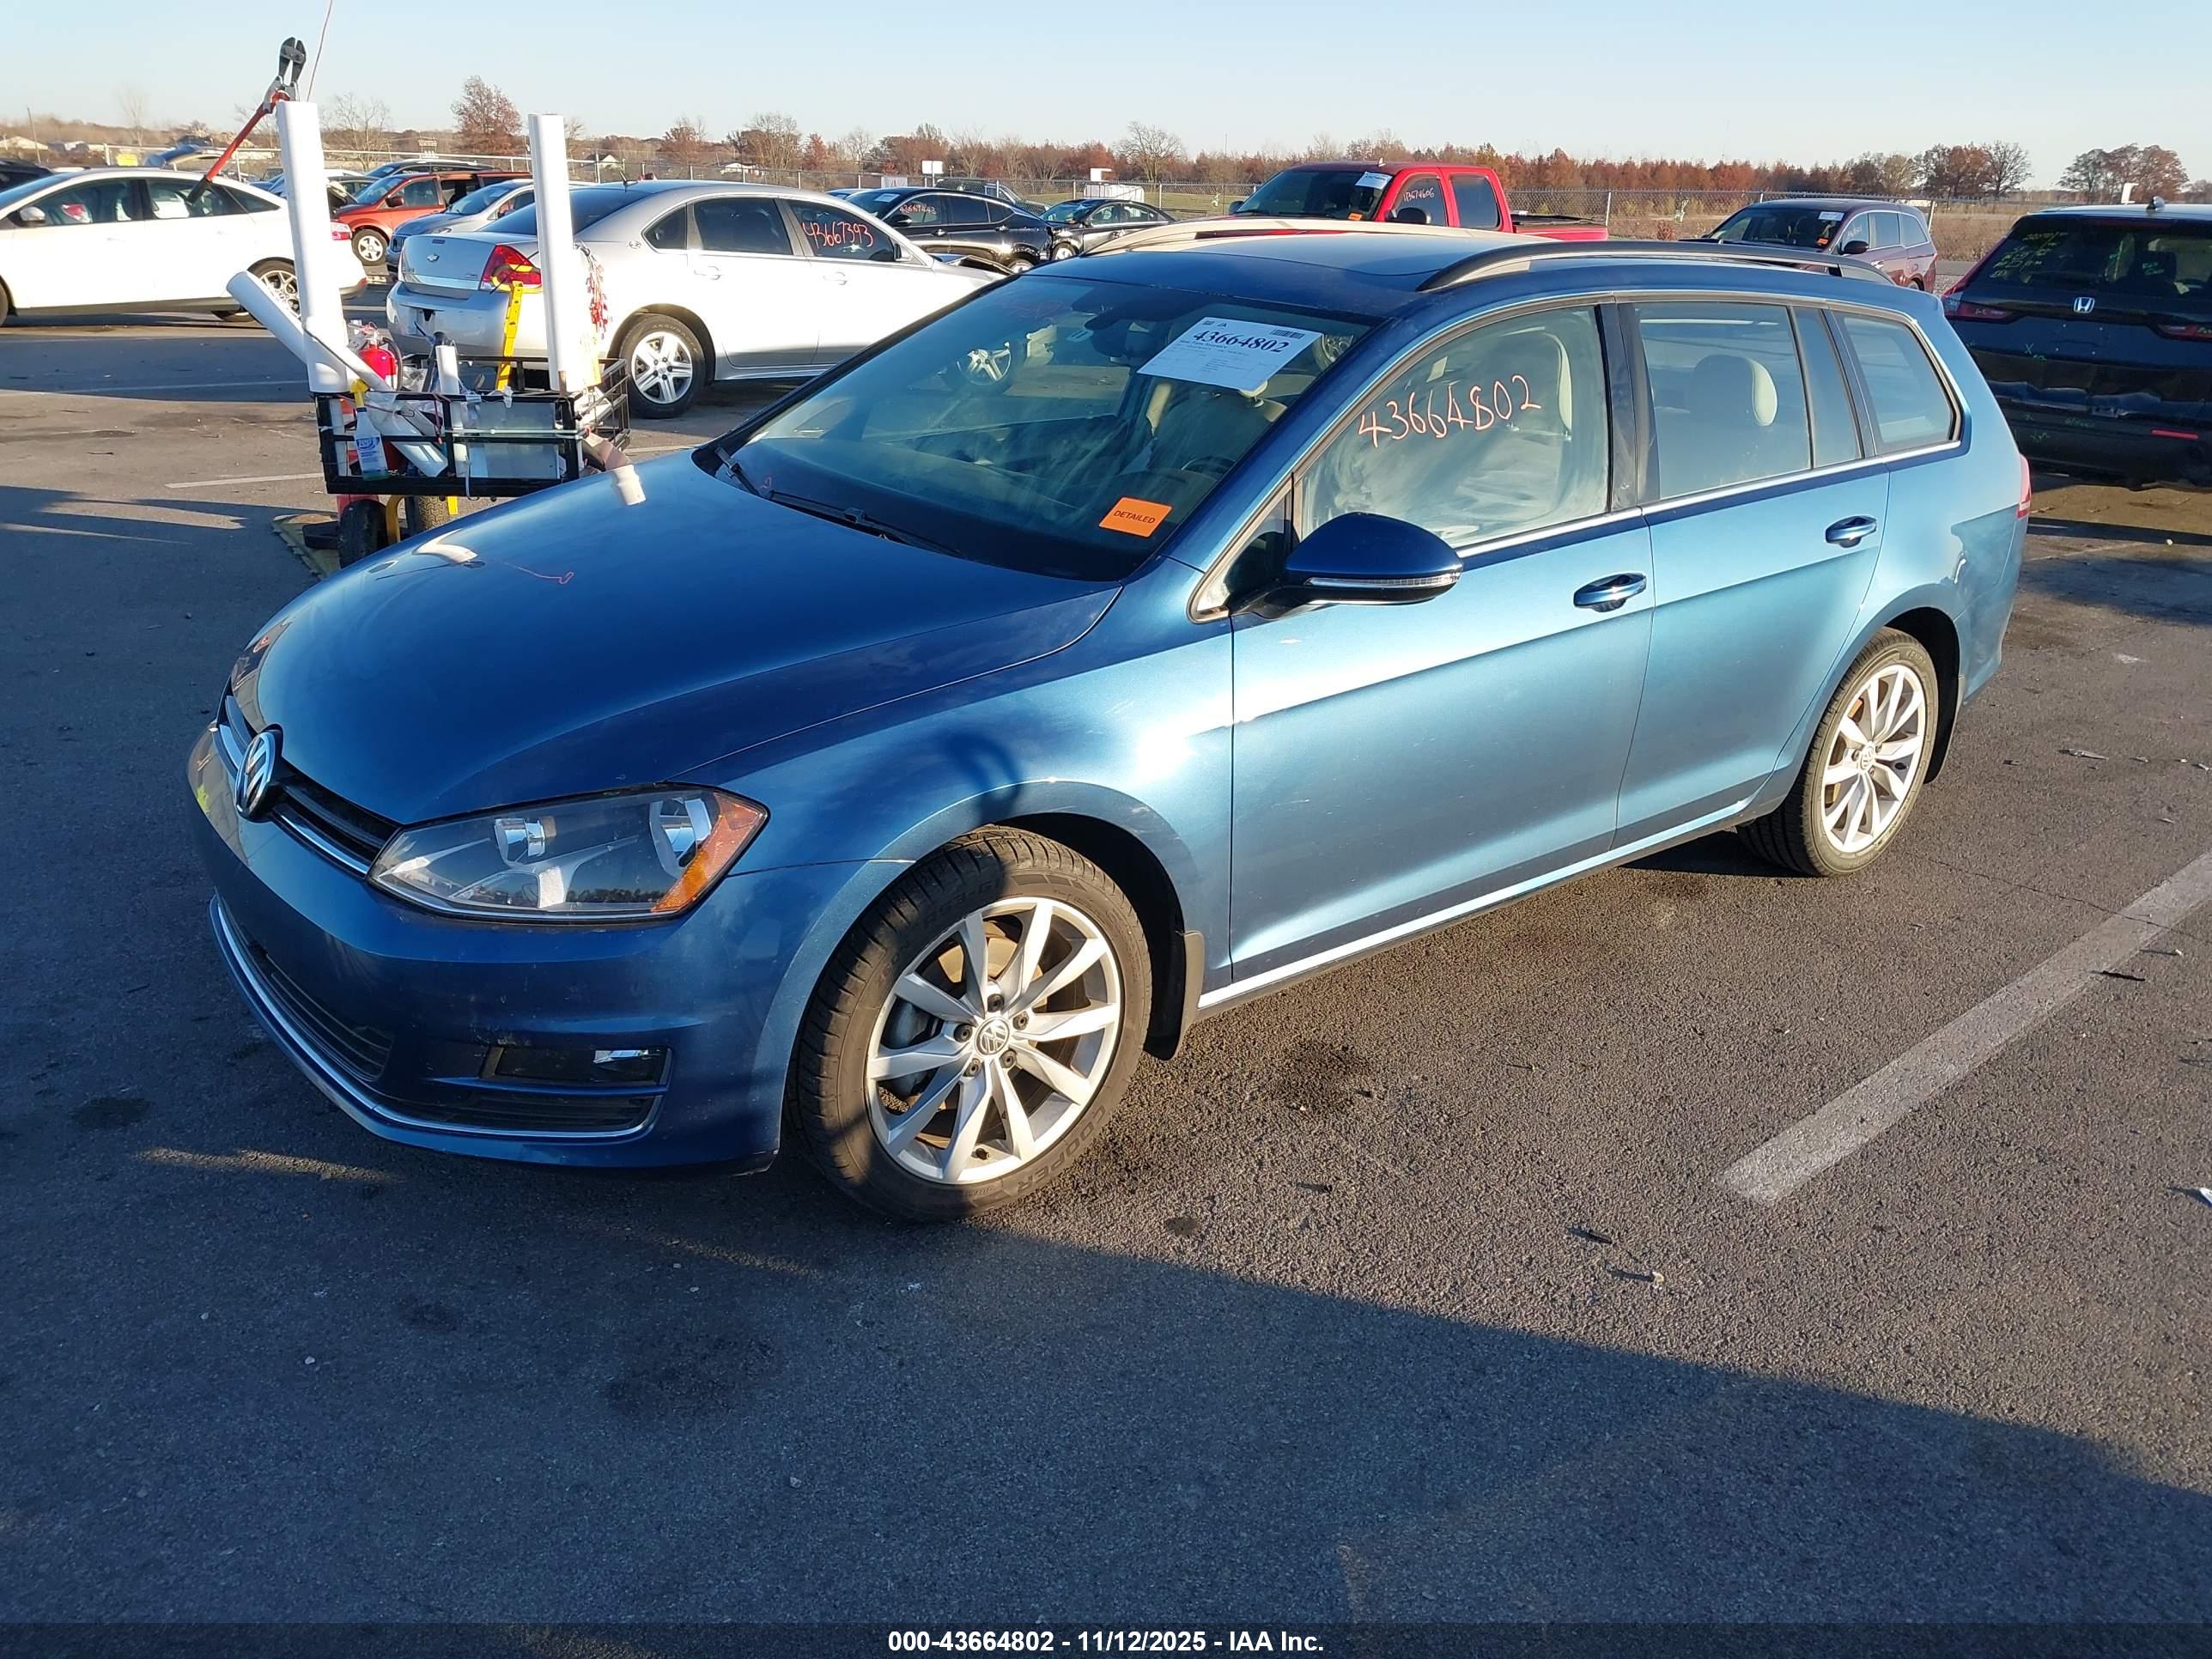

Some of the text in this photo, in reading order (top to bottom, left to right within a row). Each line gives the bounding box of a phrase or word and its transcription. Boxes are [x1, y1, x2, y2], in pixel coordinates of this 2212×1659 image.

[801, 221, 875, 249] 43667393
[1193, 330, 1290, 353] 43664802
[1358, 374, 1542, 448] 43664802
[1113, 510, 1156, 524] DETAILED
[1018, 1104, 1107, 1194] COOPER
